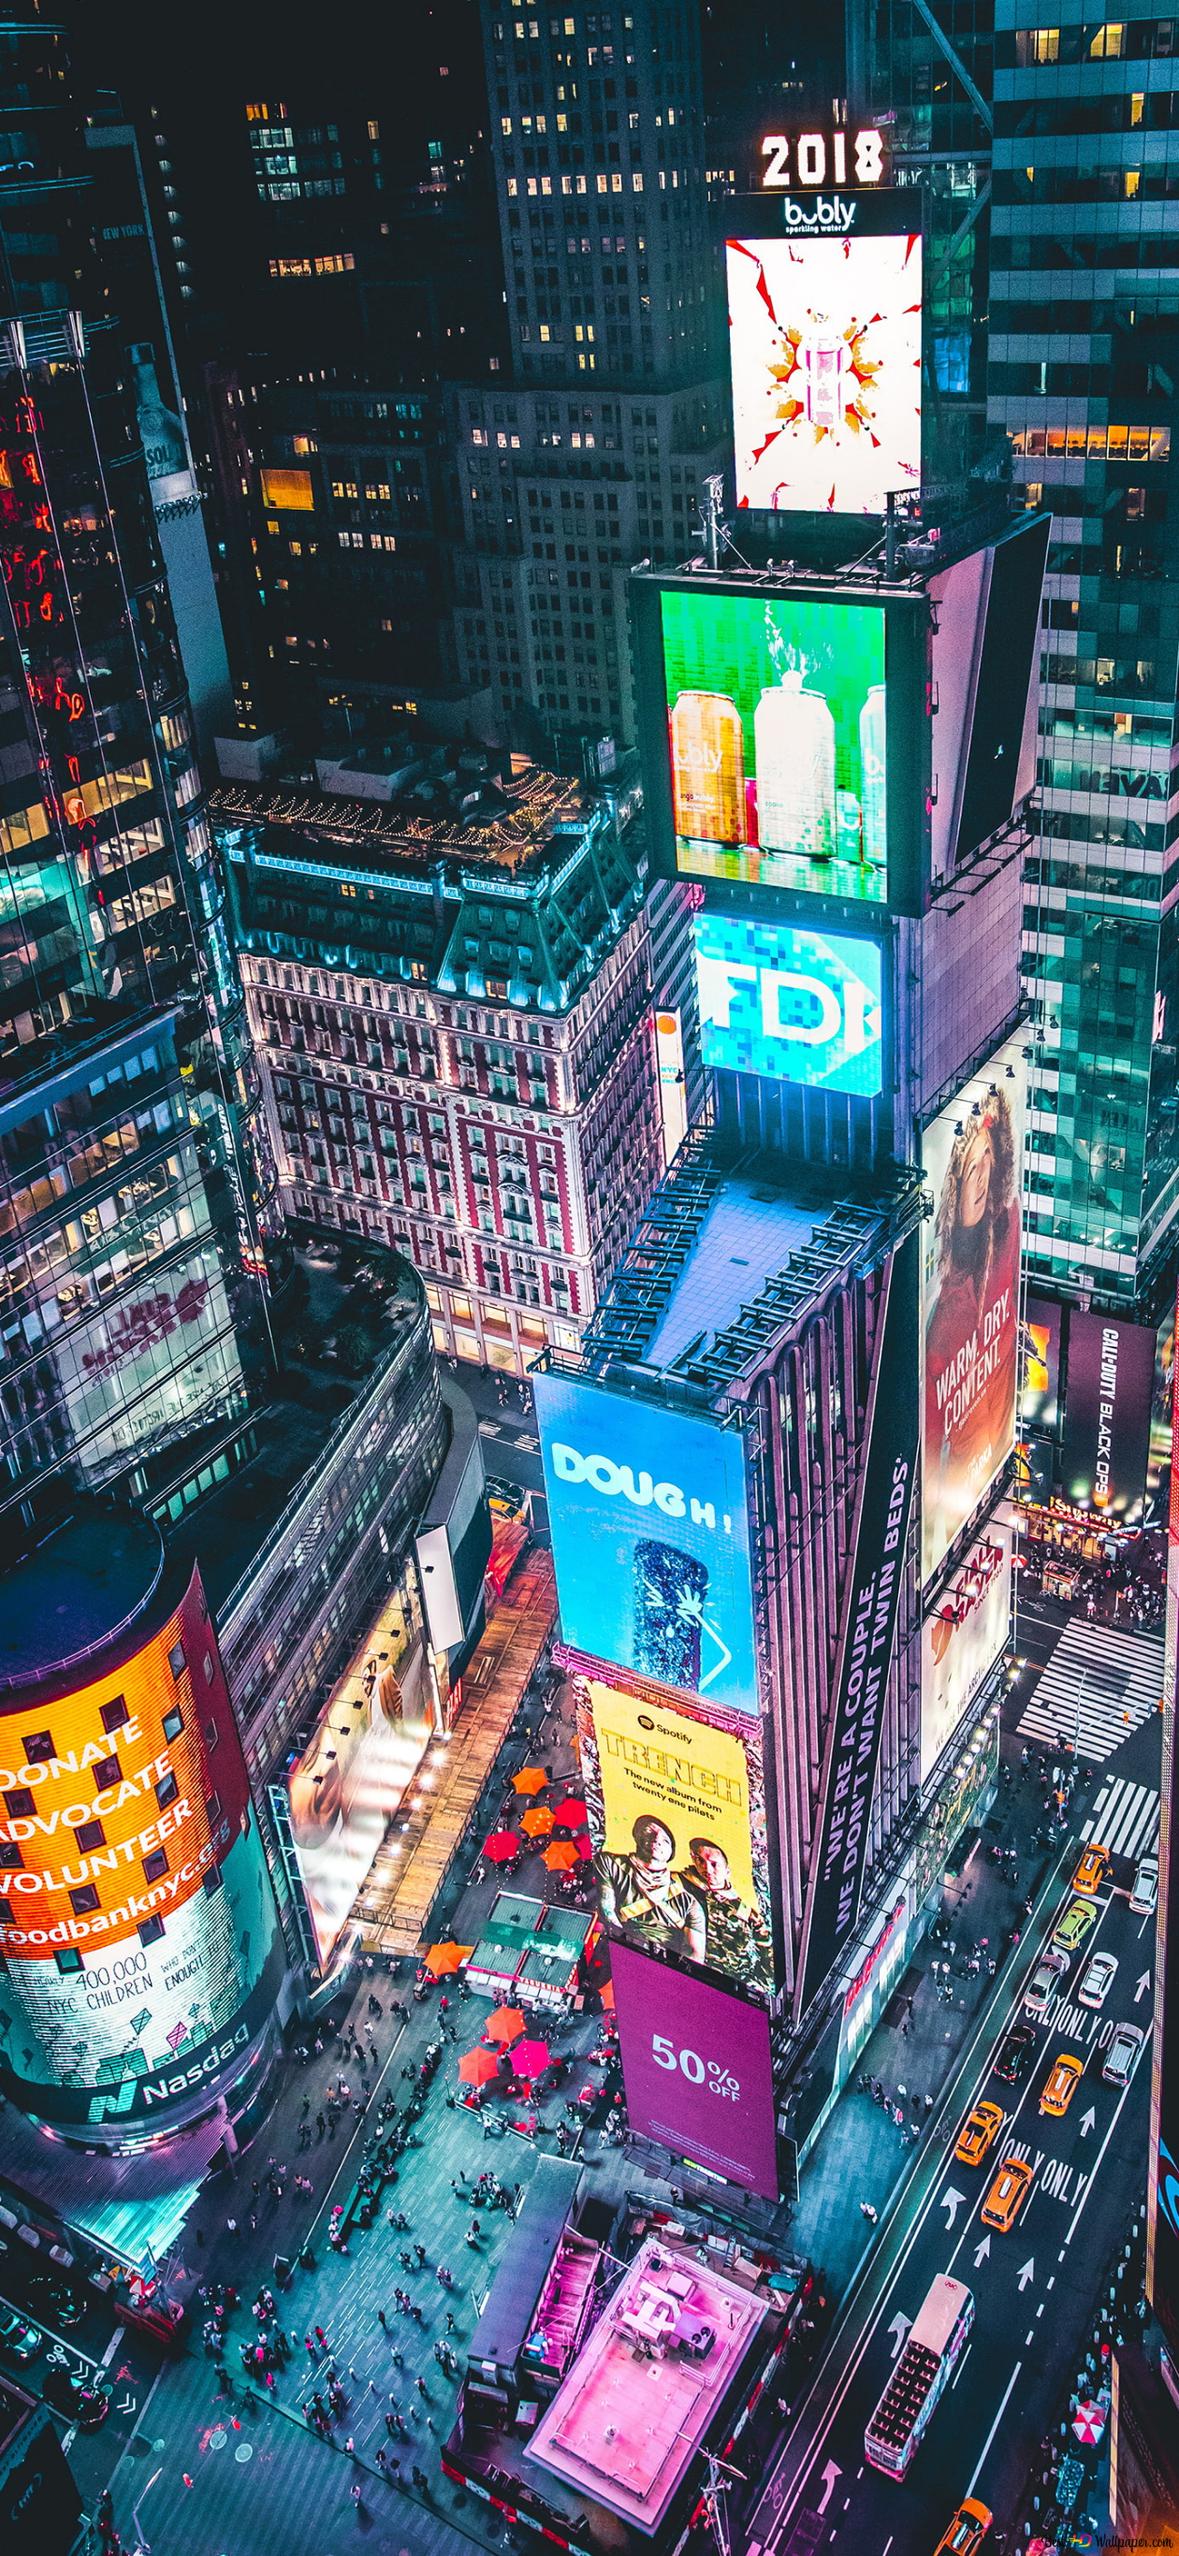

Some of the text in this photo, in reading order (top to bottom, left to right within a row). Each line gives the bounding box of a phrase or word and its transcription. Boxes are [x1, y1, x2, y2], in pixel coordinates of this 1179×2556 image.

[762, 132, 883, 186] 2018
[936, 1330, 980, 1409] WARM.
[983, 1287, 1010, 1346] DRY.
[1097, 1403, 1113, 1460] BLACK
[551, 1442, 731, 1535] DOUGH!
[1095, 1461, 1110, 1495] OPS
[870, 1560, 896, 1656] TWIN
[656, 1723, 693, 1745] Spotify
[841, 1722, 857, 1747] A
[857, 1665, 882, 1766] WANT
[601, 1727, 742, 1807] TRENCH
[624, 1766, 722, 1814] The new album from
[632, 1781, 667, 1802] twenty
[842, 1772, 869, 1873] DON'T
[835, 1876, 855, 1935] WE
[48, 1973, 153, 2015] NYC CHILDREN
[75, 1951, 147, 1991] 400,000
[1057, 2004, 1102, 2045] ONLY
[142, 2022, 250, 2105] Nasdaq
[652, 2034, 740, 2091] 50%
[708, 2081, 740, 2102] OFF
[1041, 2159, 1088, 2208] ONLY
